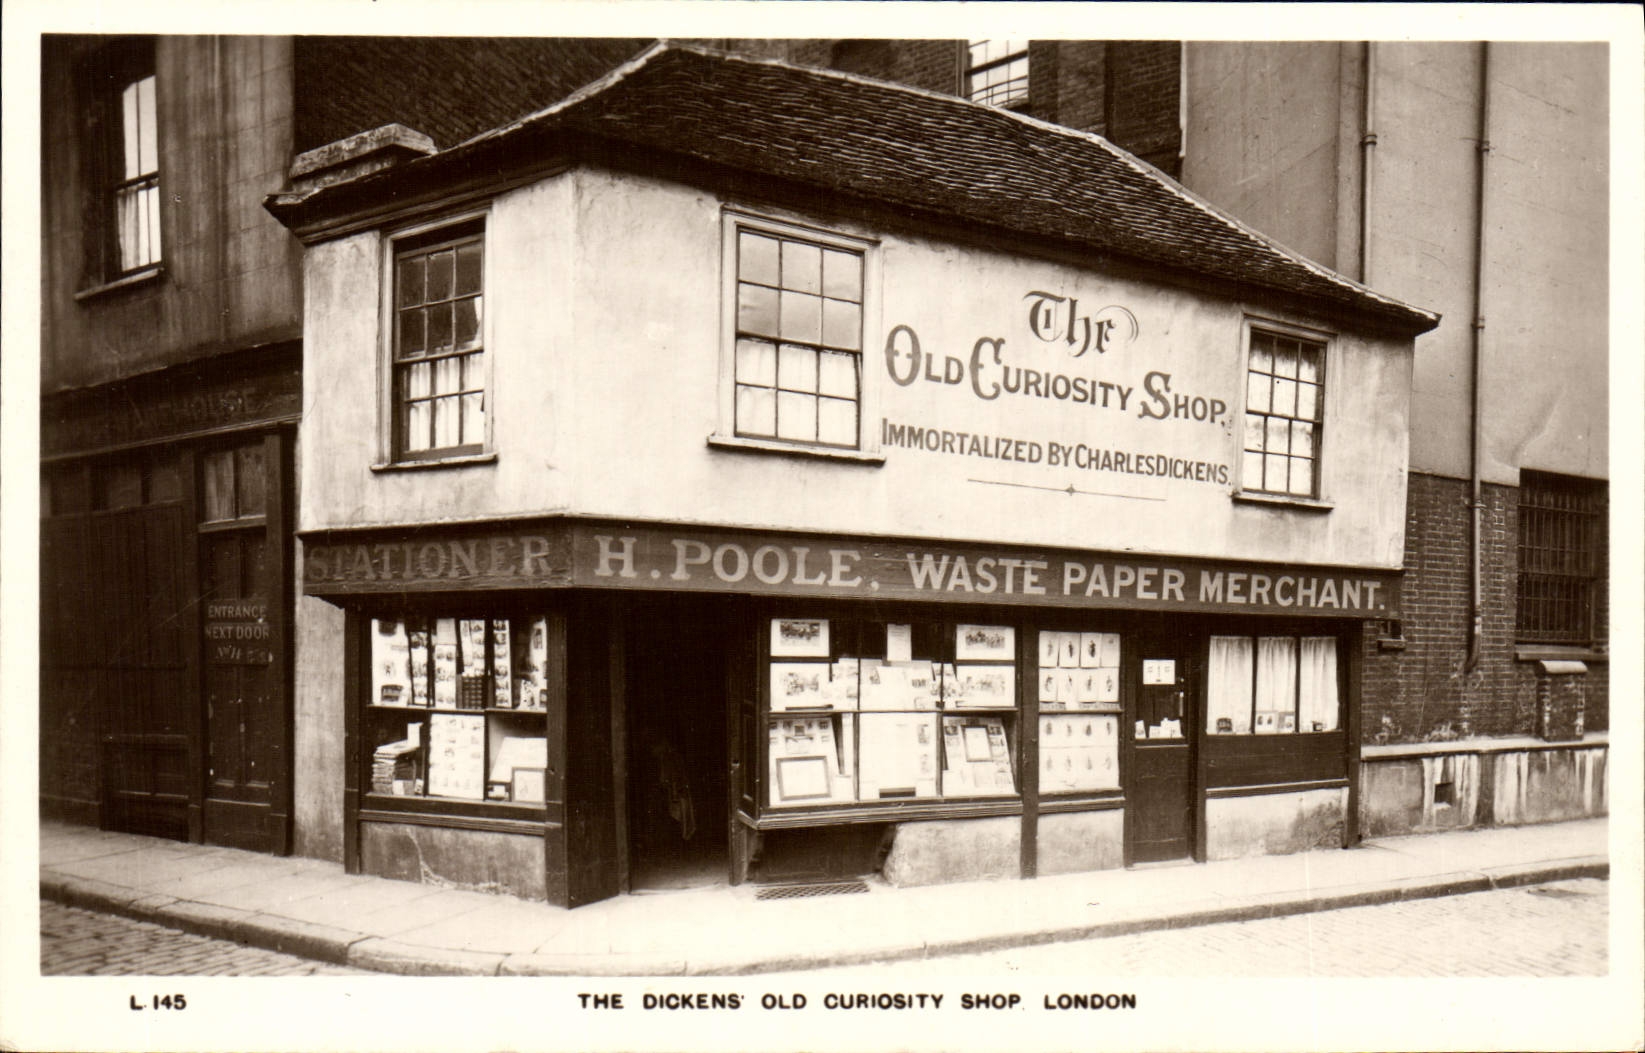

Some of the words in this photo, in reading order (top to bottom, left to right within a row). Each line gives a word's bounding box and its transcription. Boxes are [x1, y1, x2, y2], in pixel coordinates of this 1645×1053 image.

[1023, 290, 1139, 358] The
[884, 324, 965, 387] OLD
[968, 336, 1135, 412] CURIOSITY
[881, 417, 1043, 464] IMMORTALIZED
[1047, 440, 1074, 467] BY
[1074, 443, 1156, 478] CHARLES
[305, 535, 553, 583] STATIONER
[906, 552, 1049, 597] WASTE
[1063, 561, 1186, 602] PAPER
[1200, 570, 1387, 612] MERCHANT.
[204, 624, 234, 640] NEXT
[236, 624, 270, 640] DOOR
[208, 604, 267, 618] ENTRANCE
